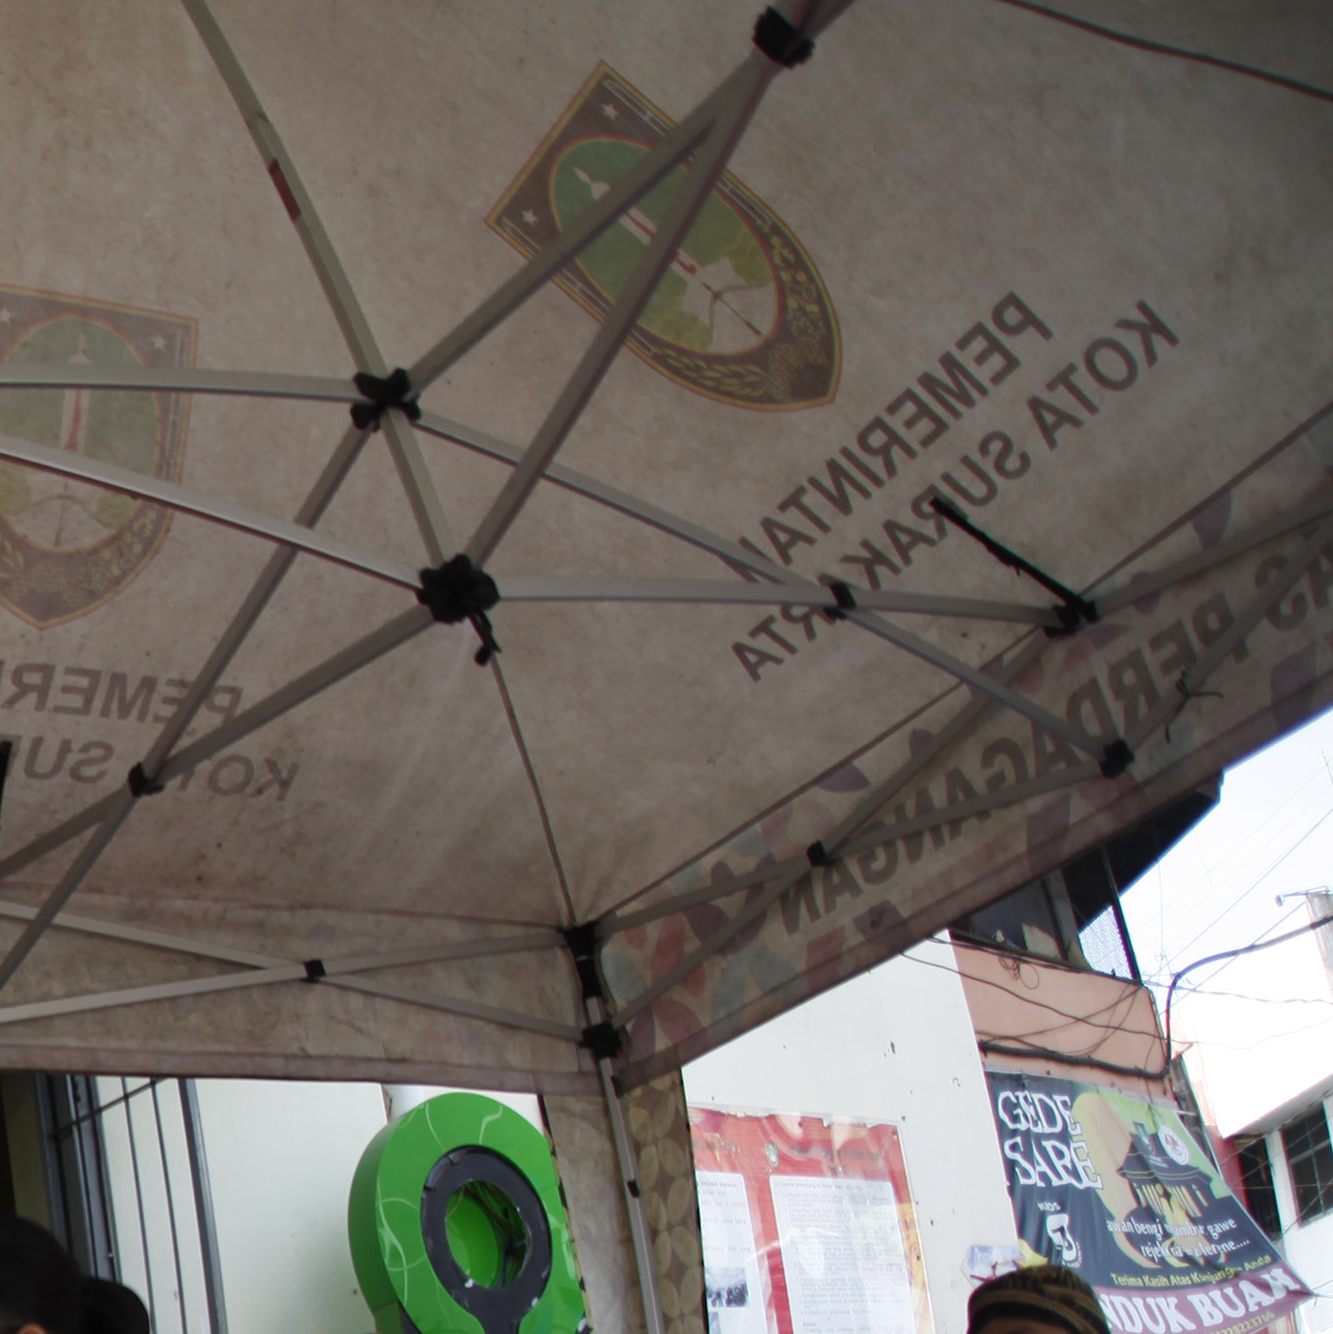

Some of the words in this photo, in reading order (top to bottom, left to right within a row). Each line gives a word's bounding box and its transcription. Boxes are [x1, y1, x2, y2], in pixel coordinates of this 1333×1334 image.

[997, 1090, 1083, 1136] GEDE
[1207, 1219, 1238, 1240] gawe
[1111, 1273, 1143, 1288] Terima
[1144, 1275, 1171, 1287] Kasih
[1171, 1273, 1191, 1286] Atas
[1244, 1254, 1273, 1272] Anda
[1187, 1267, 1302, 1328] BUAH
